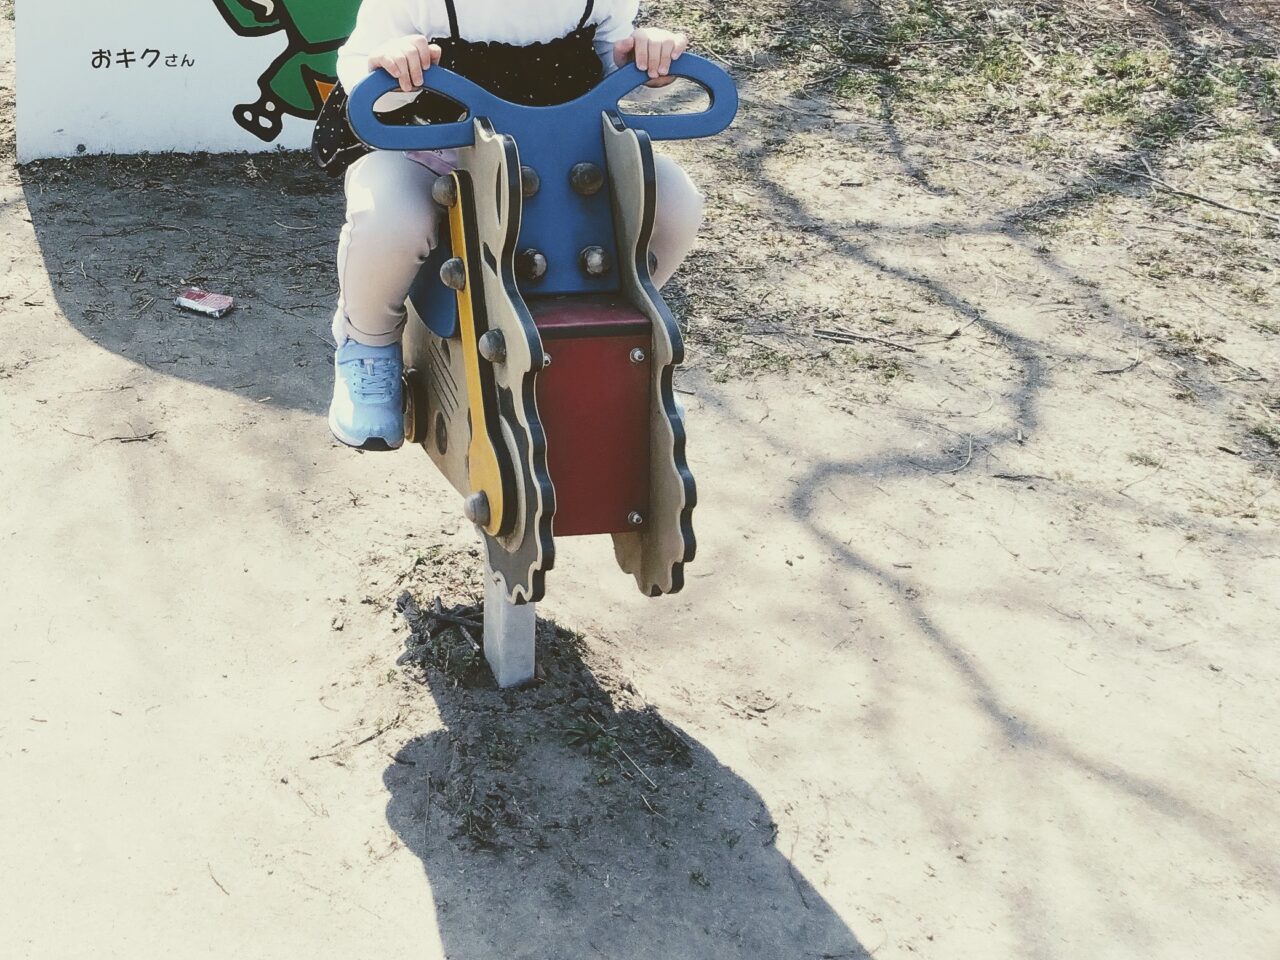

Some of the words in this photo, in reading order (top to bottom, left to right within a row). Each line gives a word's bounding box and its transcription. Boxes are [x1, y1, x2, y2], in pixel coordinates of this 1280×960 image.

[90, 47, 196, 69] おキクさん
